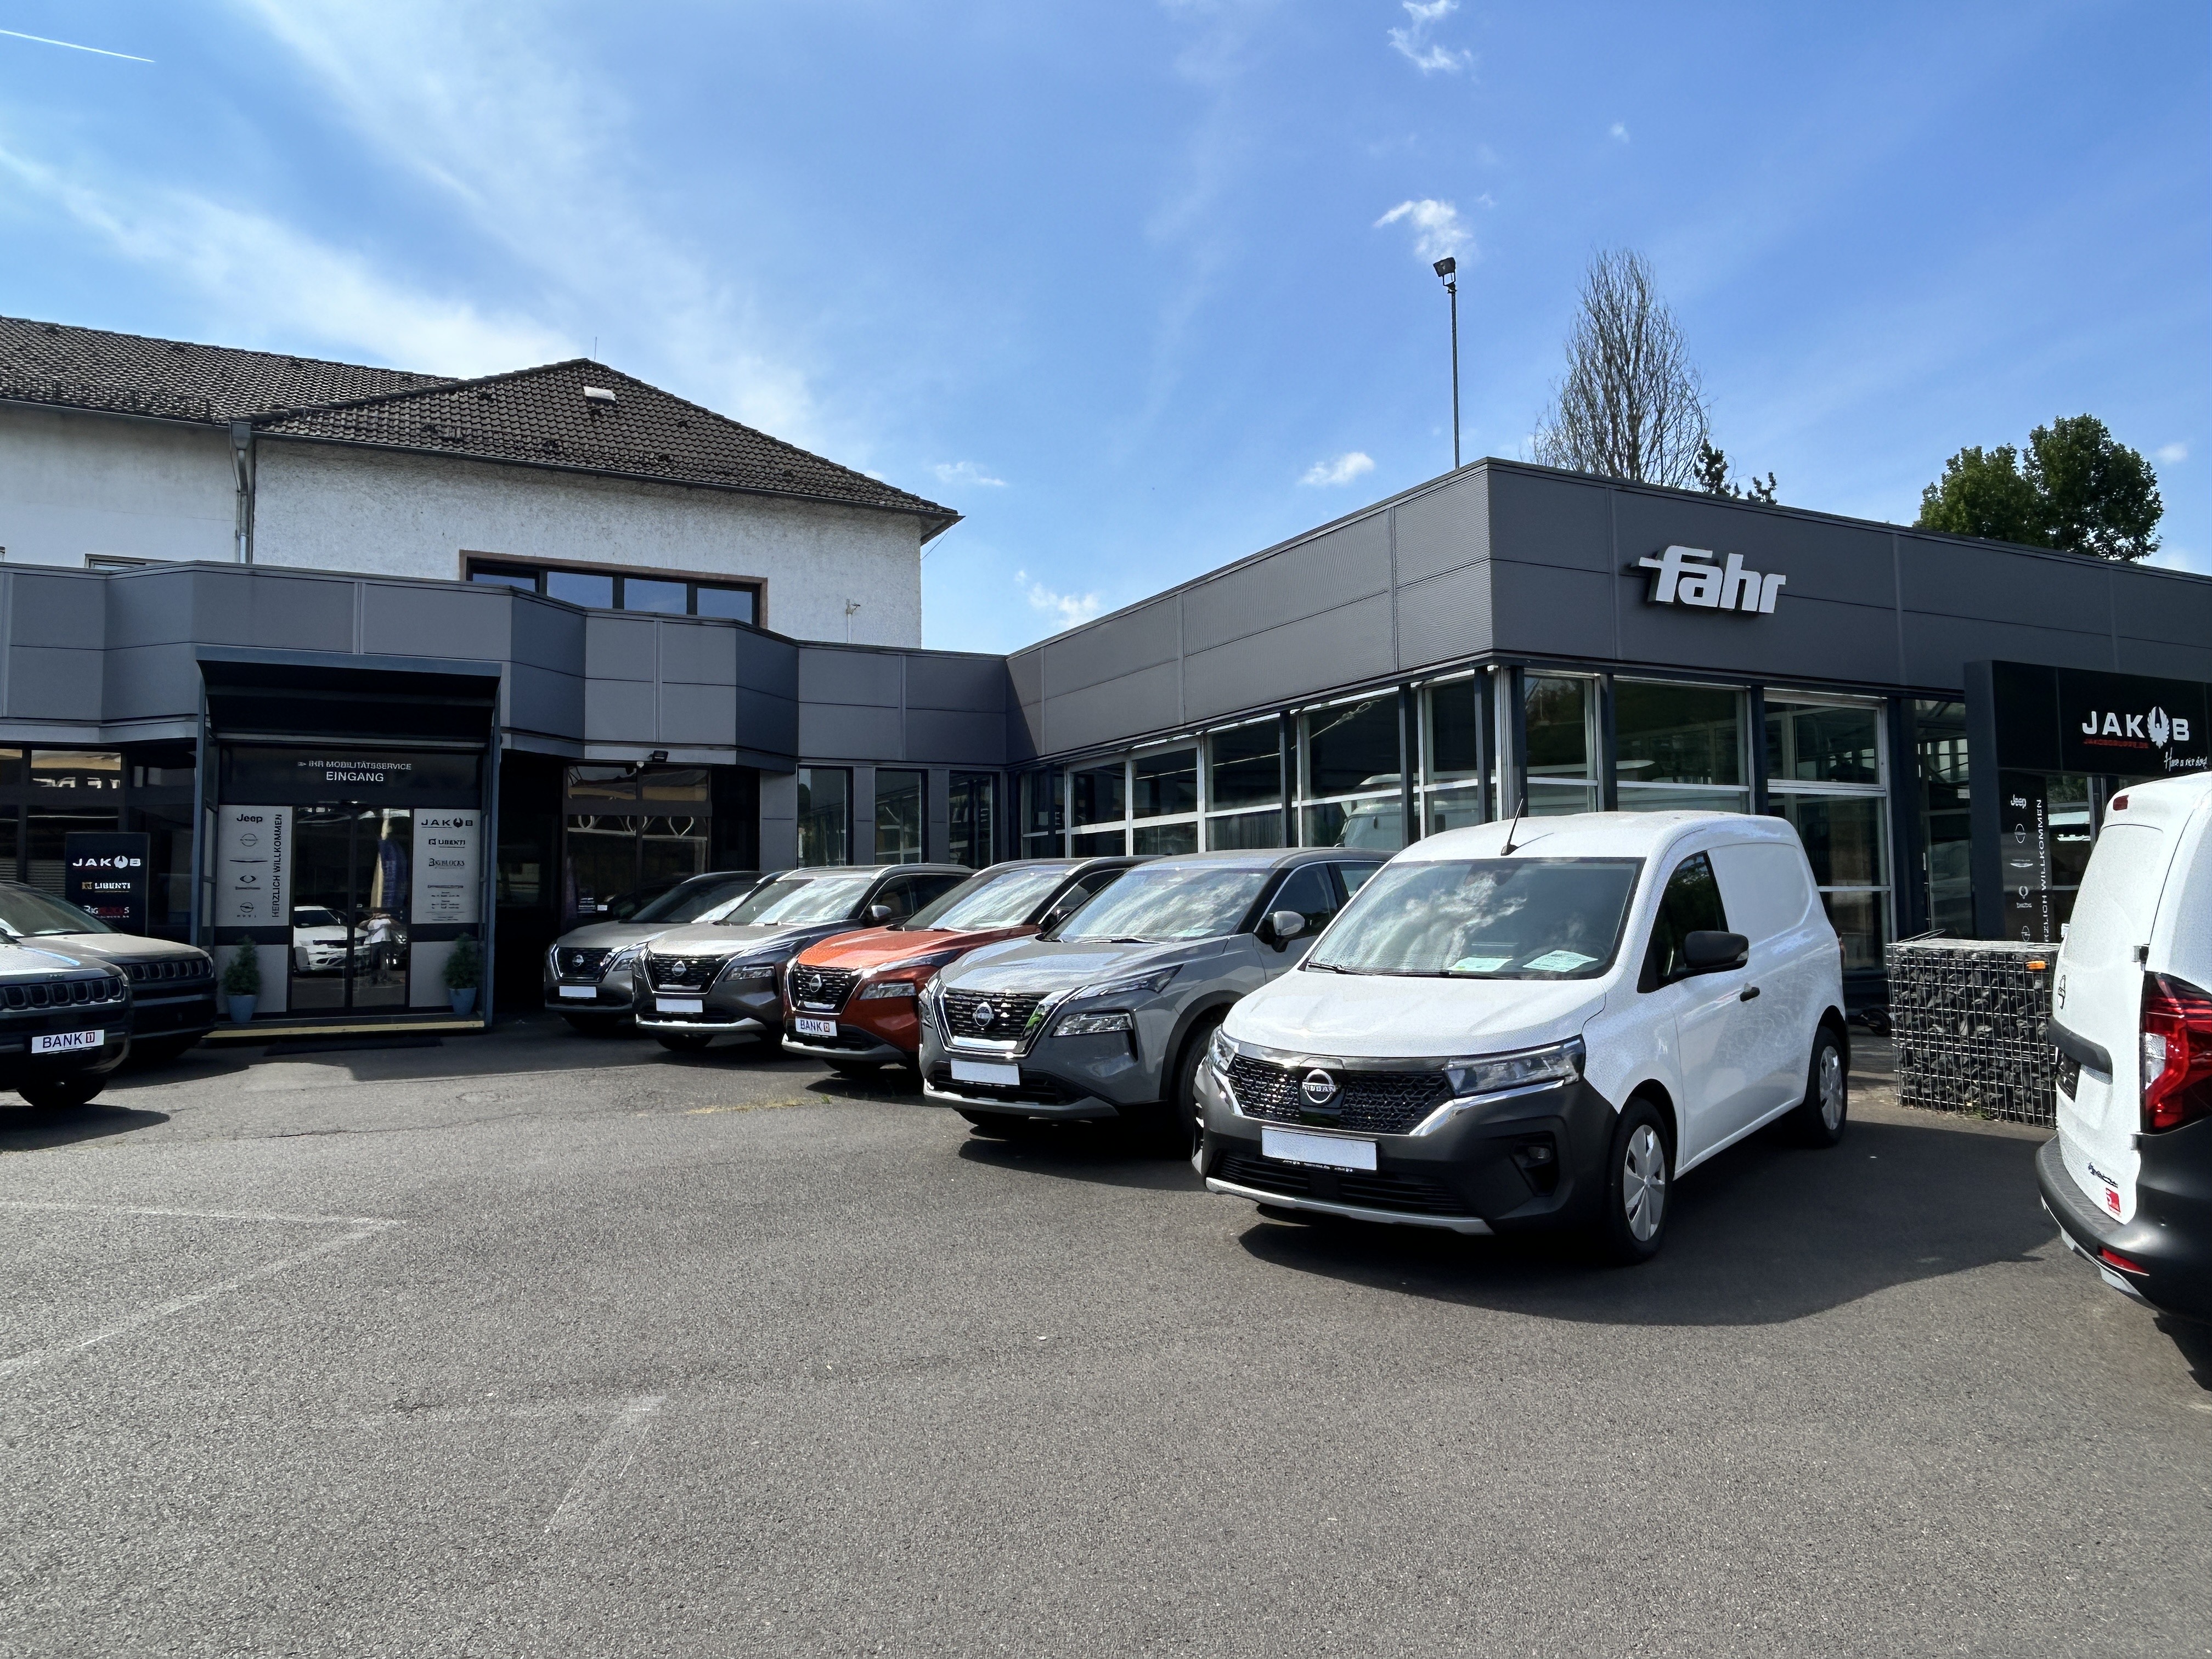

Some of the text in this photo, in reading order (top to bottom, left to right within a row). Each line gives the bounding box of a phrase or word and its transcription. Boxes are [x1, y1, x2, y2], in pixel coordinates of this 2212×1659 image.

[1638, 545, 1786, 613] fahr
[326, 771, 384, 782] EINGANG
[236, 814, 263, 823] Jeep
[272, 814, 283, 918] HERZLICH WILLKOMMEN
[800, 1019, 823, 1032] BANK
[42, 1032, 83, 1048] BANK
